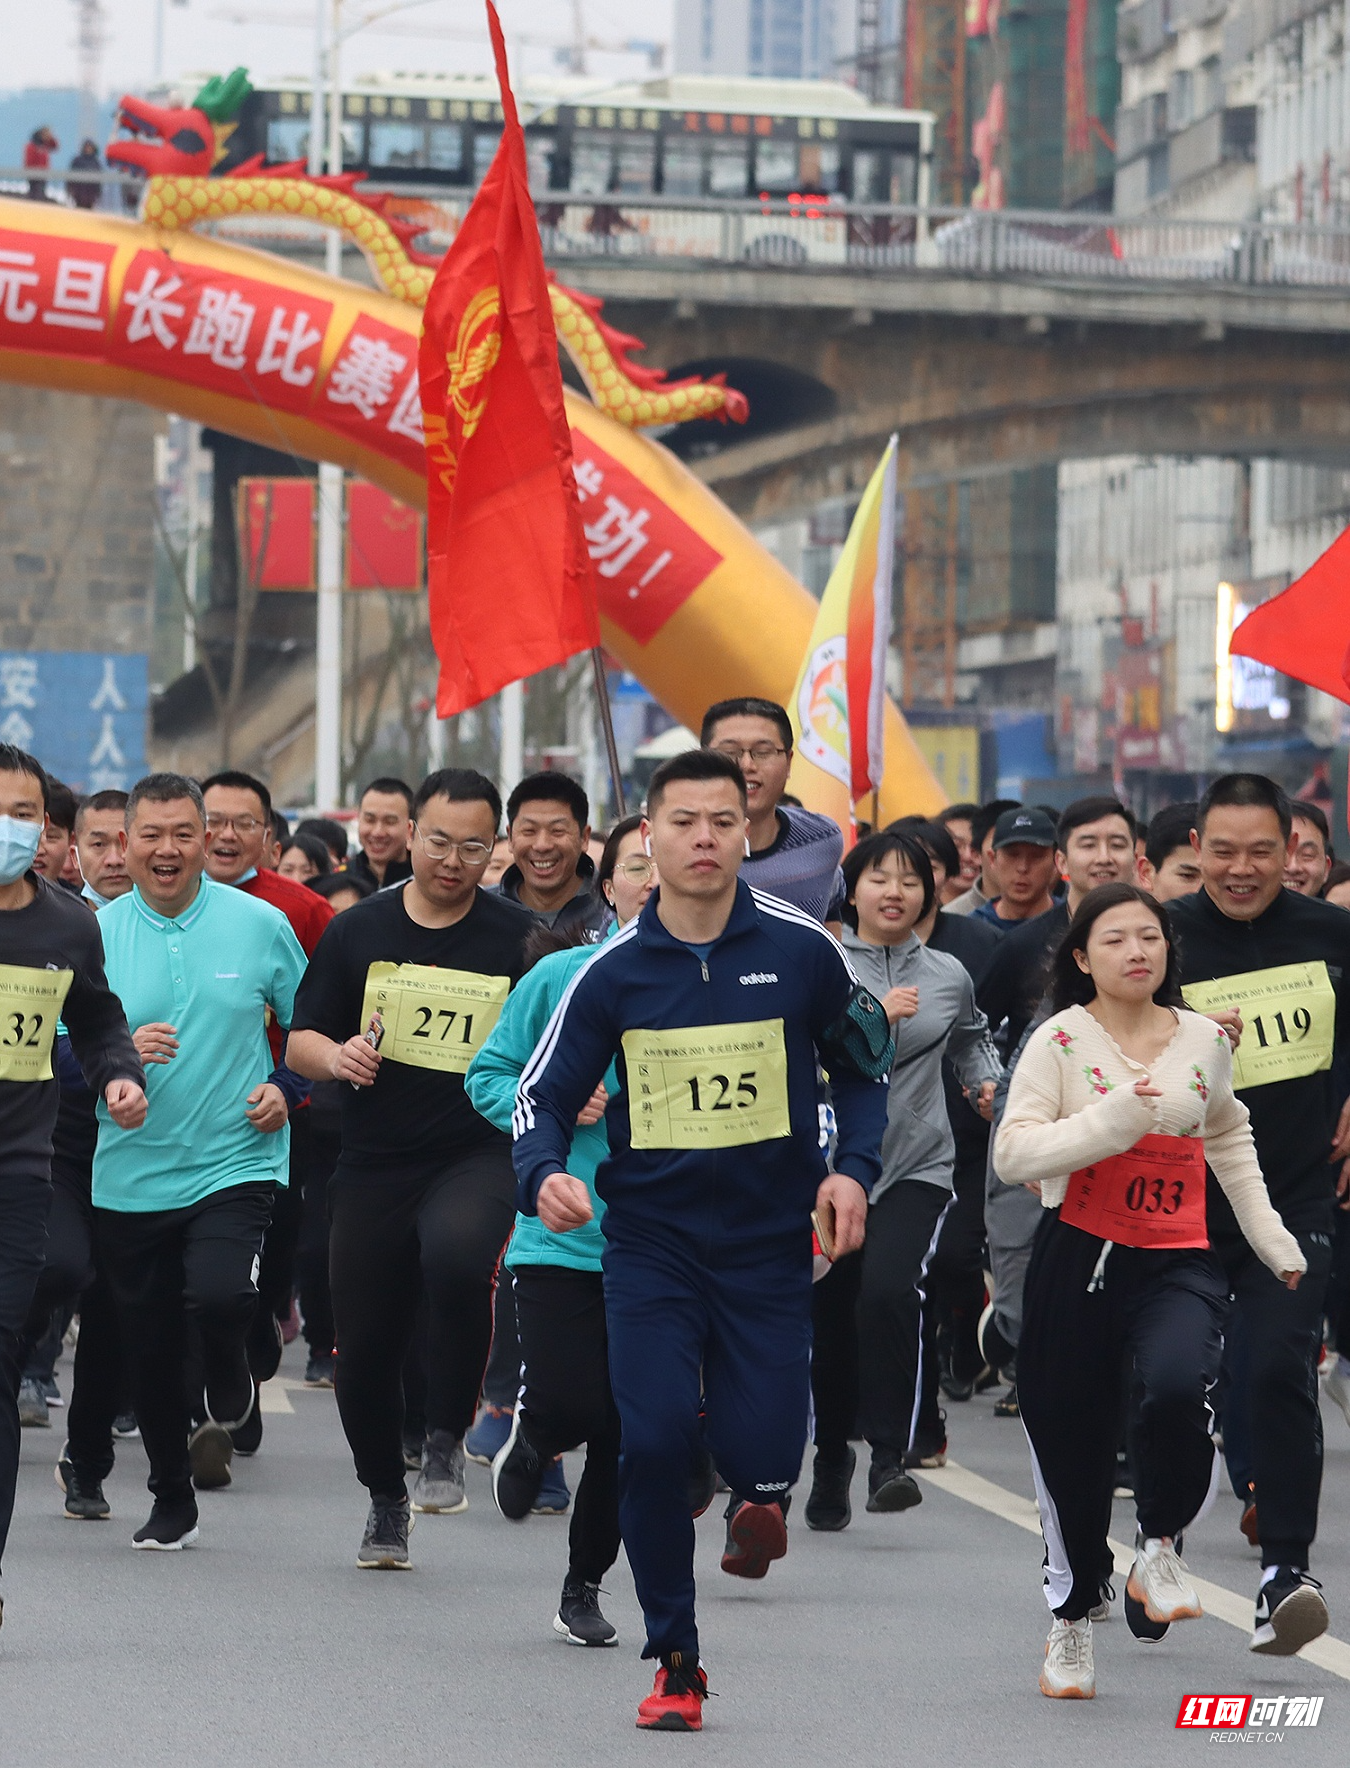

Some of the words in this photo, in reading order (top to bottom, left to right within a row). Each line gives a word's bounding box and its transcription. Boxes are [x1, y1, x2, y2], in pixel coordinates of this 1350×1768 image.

[739, 972, 779, 986] adidas
[412, 1006, 474, 1045] 271
[1250, 1007, 1311, 1049] 119
[687, 1072, 758, 1112] 125
[1125, 1175, 1185, 1215] 033
[755, 1481, 789, 1491] adidas
